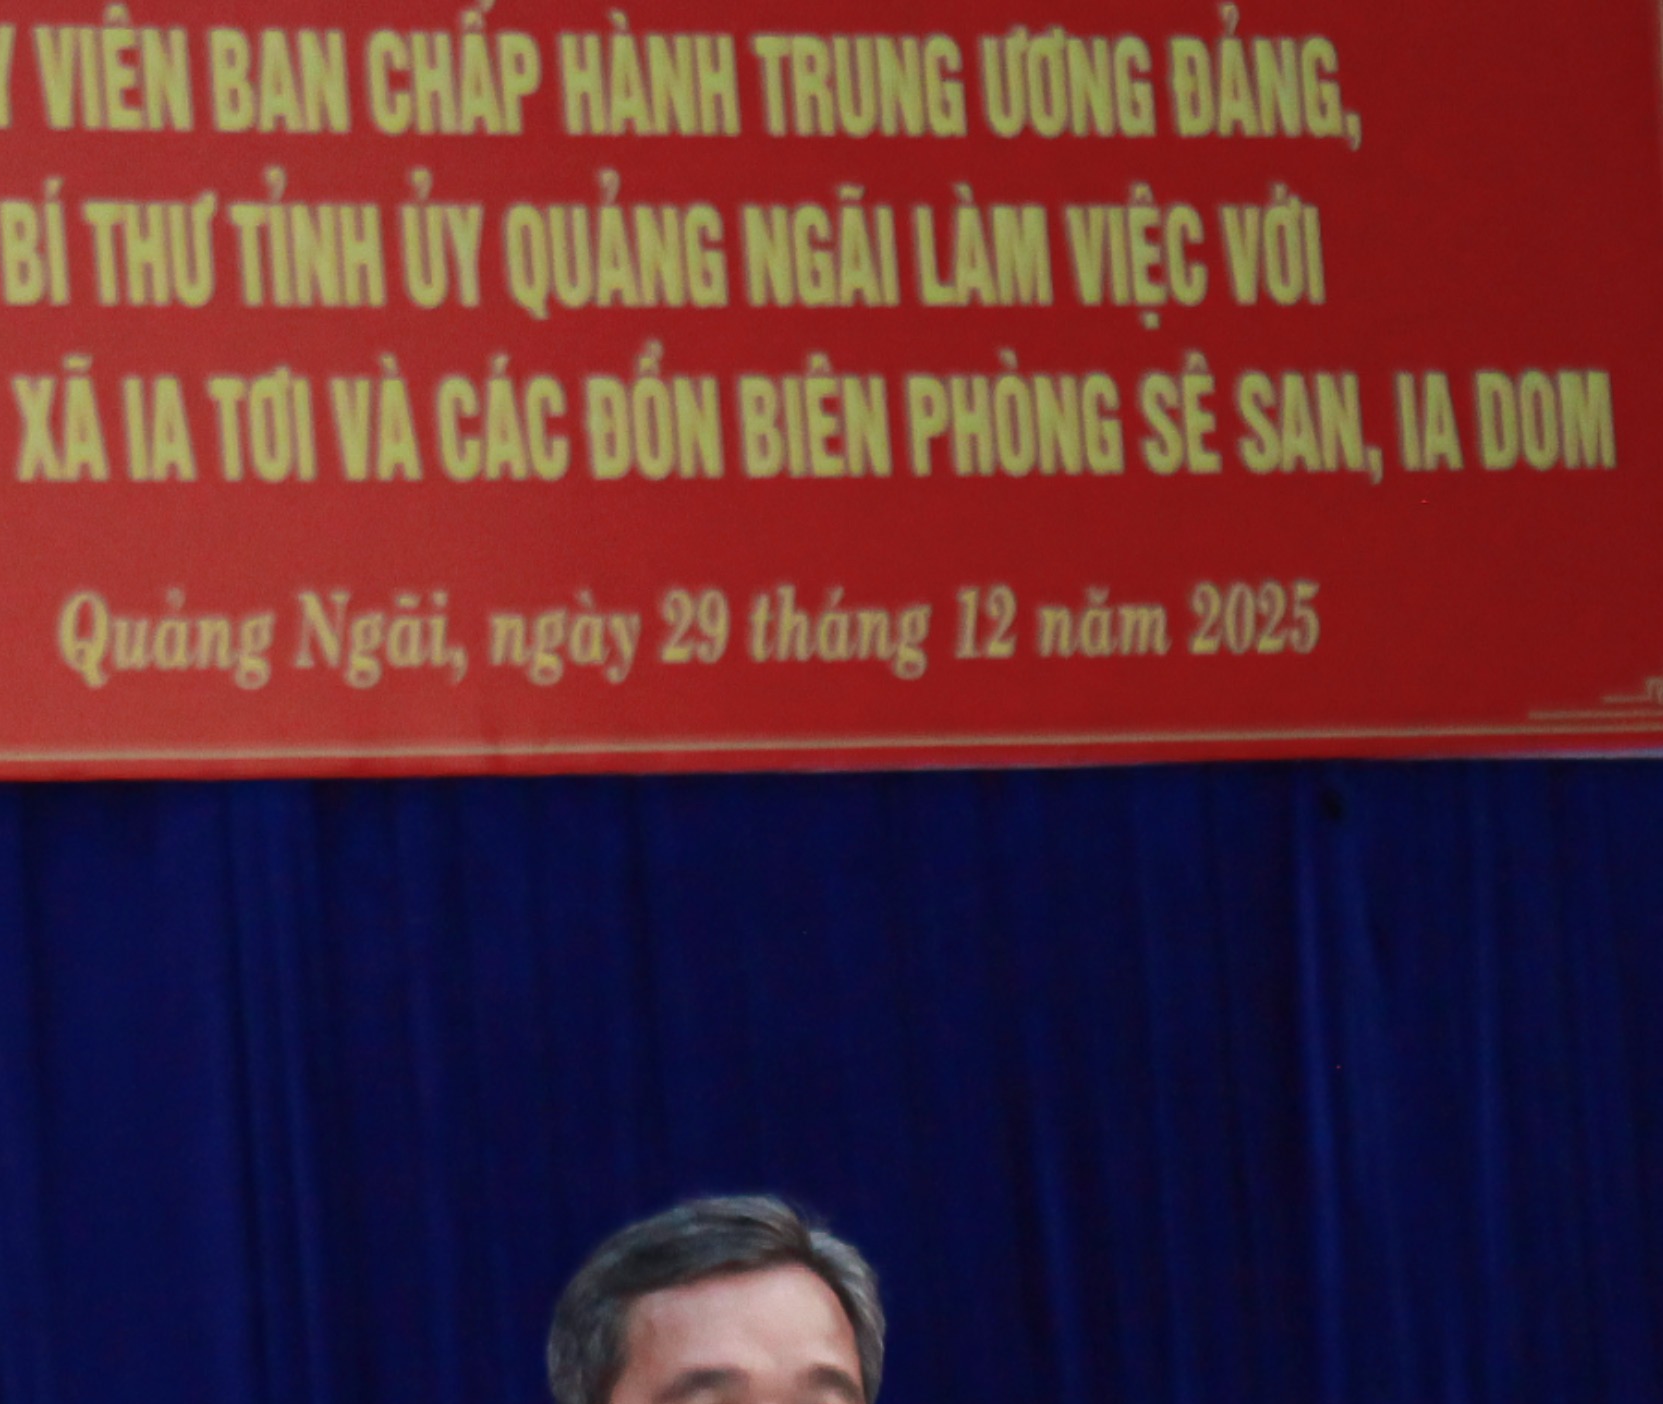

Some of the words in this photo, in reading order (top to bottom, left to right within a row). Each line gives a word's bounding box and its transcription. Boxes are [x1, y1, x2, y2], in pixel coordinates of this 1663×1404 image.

[33, 4, 193, 131] VIÊN
[208, 27, 350, 133] BAN
[366, 0, 540, 135] CHẤP
[558, 11, 740, 135] HÀNH
[751, 33, 966, 137] TRUNG
[980, 26, 1155, 137] ƯƠNG
[1169, 3, 1360, 148] ĐẢNG,
[82, 192, 216, 307] THƯ
[227, 166, 385, 307] TỈNH
[400, 168, 483, 308] ỦY
[503, 169, 727, 319] QUẢNG
[742, 185, 899, 307] NGÃI
[913, 184, 1052, 306] LÀM
[1065, 183, 1207, 328] VIỆC
[1220, 184, 1324, 305] VỚI
[12, 355, 108, 481] XÃ
[123, 375, 196, 481] IA
[207, 366, 316, 482] TƠI
[329, 355, 421, 481] VÀ
[435, 354, 569, 481] CÁC
[585, 341, 723, 479] ĐỒN
[736, 353, 891, 478] BIÊN
[905, 350, 1123, 476] PHÒNG
[1139, 352, 1220, 474] SÊ
[1236, 371, 1382, 482] SAN,
[1396, 371, 1462, 470] IA
[1475, 369, 1615, 470] DOM
[57, 589, 274, 689] Quảng
[294, 590, 467, 688] Ngãi,
[489, 590, 640, 685] ngày
[660, 588, 729, 663] 29
[749, 584, 930, 679] tháng
[956, 585, 1016, 658] 12
[1038, 588, 1169, 657] năm
[1189, 580, 1319, 654] 2025
